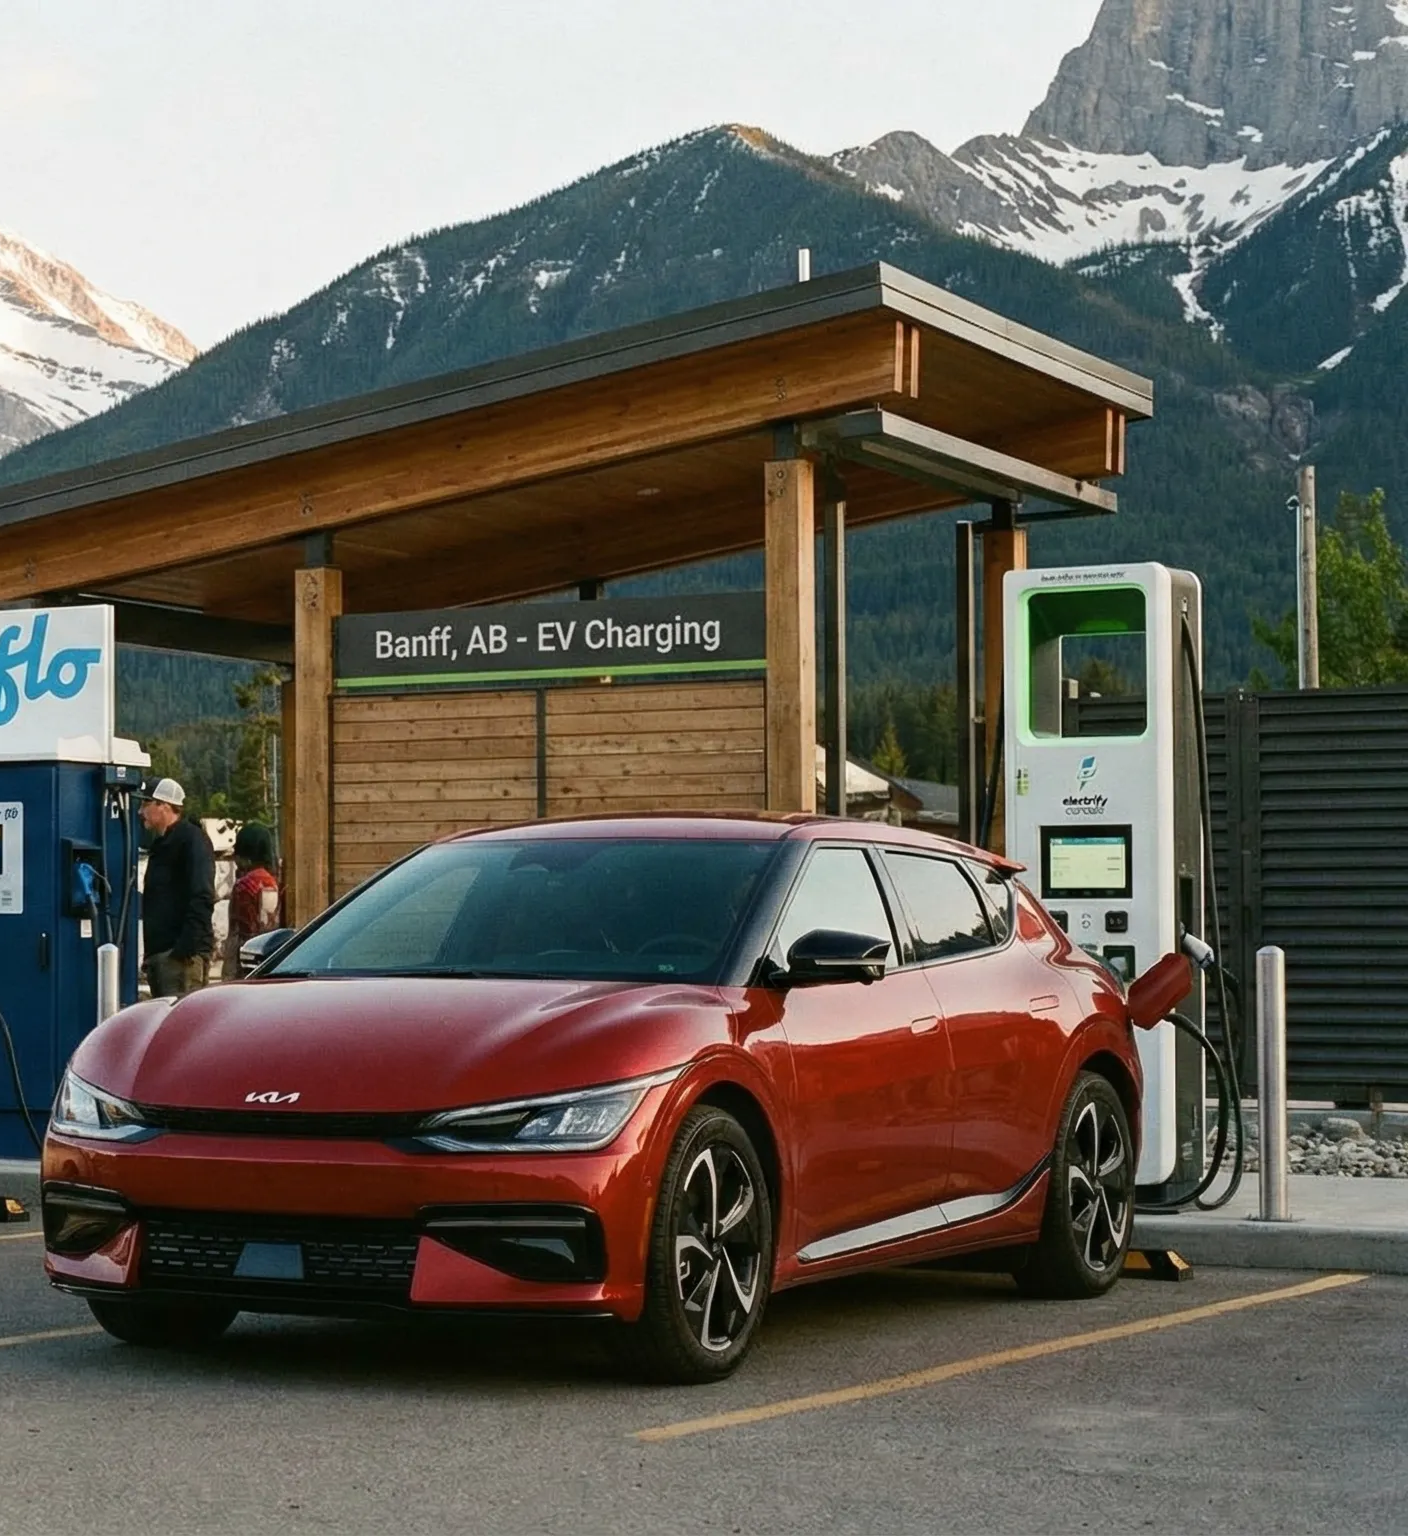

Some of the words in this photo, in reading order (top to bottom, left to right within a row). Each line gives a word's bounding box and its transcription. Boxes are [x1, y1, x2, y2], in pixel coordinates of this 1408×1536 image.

[375, 625, 458, 661] Banff,
[466, 624, 508, 656] AB
[538, 620, 577, 651] EV
[585, 614, 721, 652] Charging
